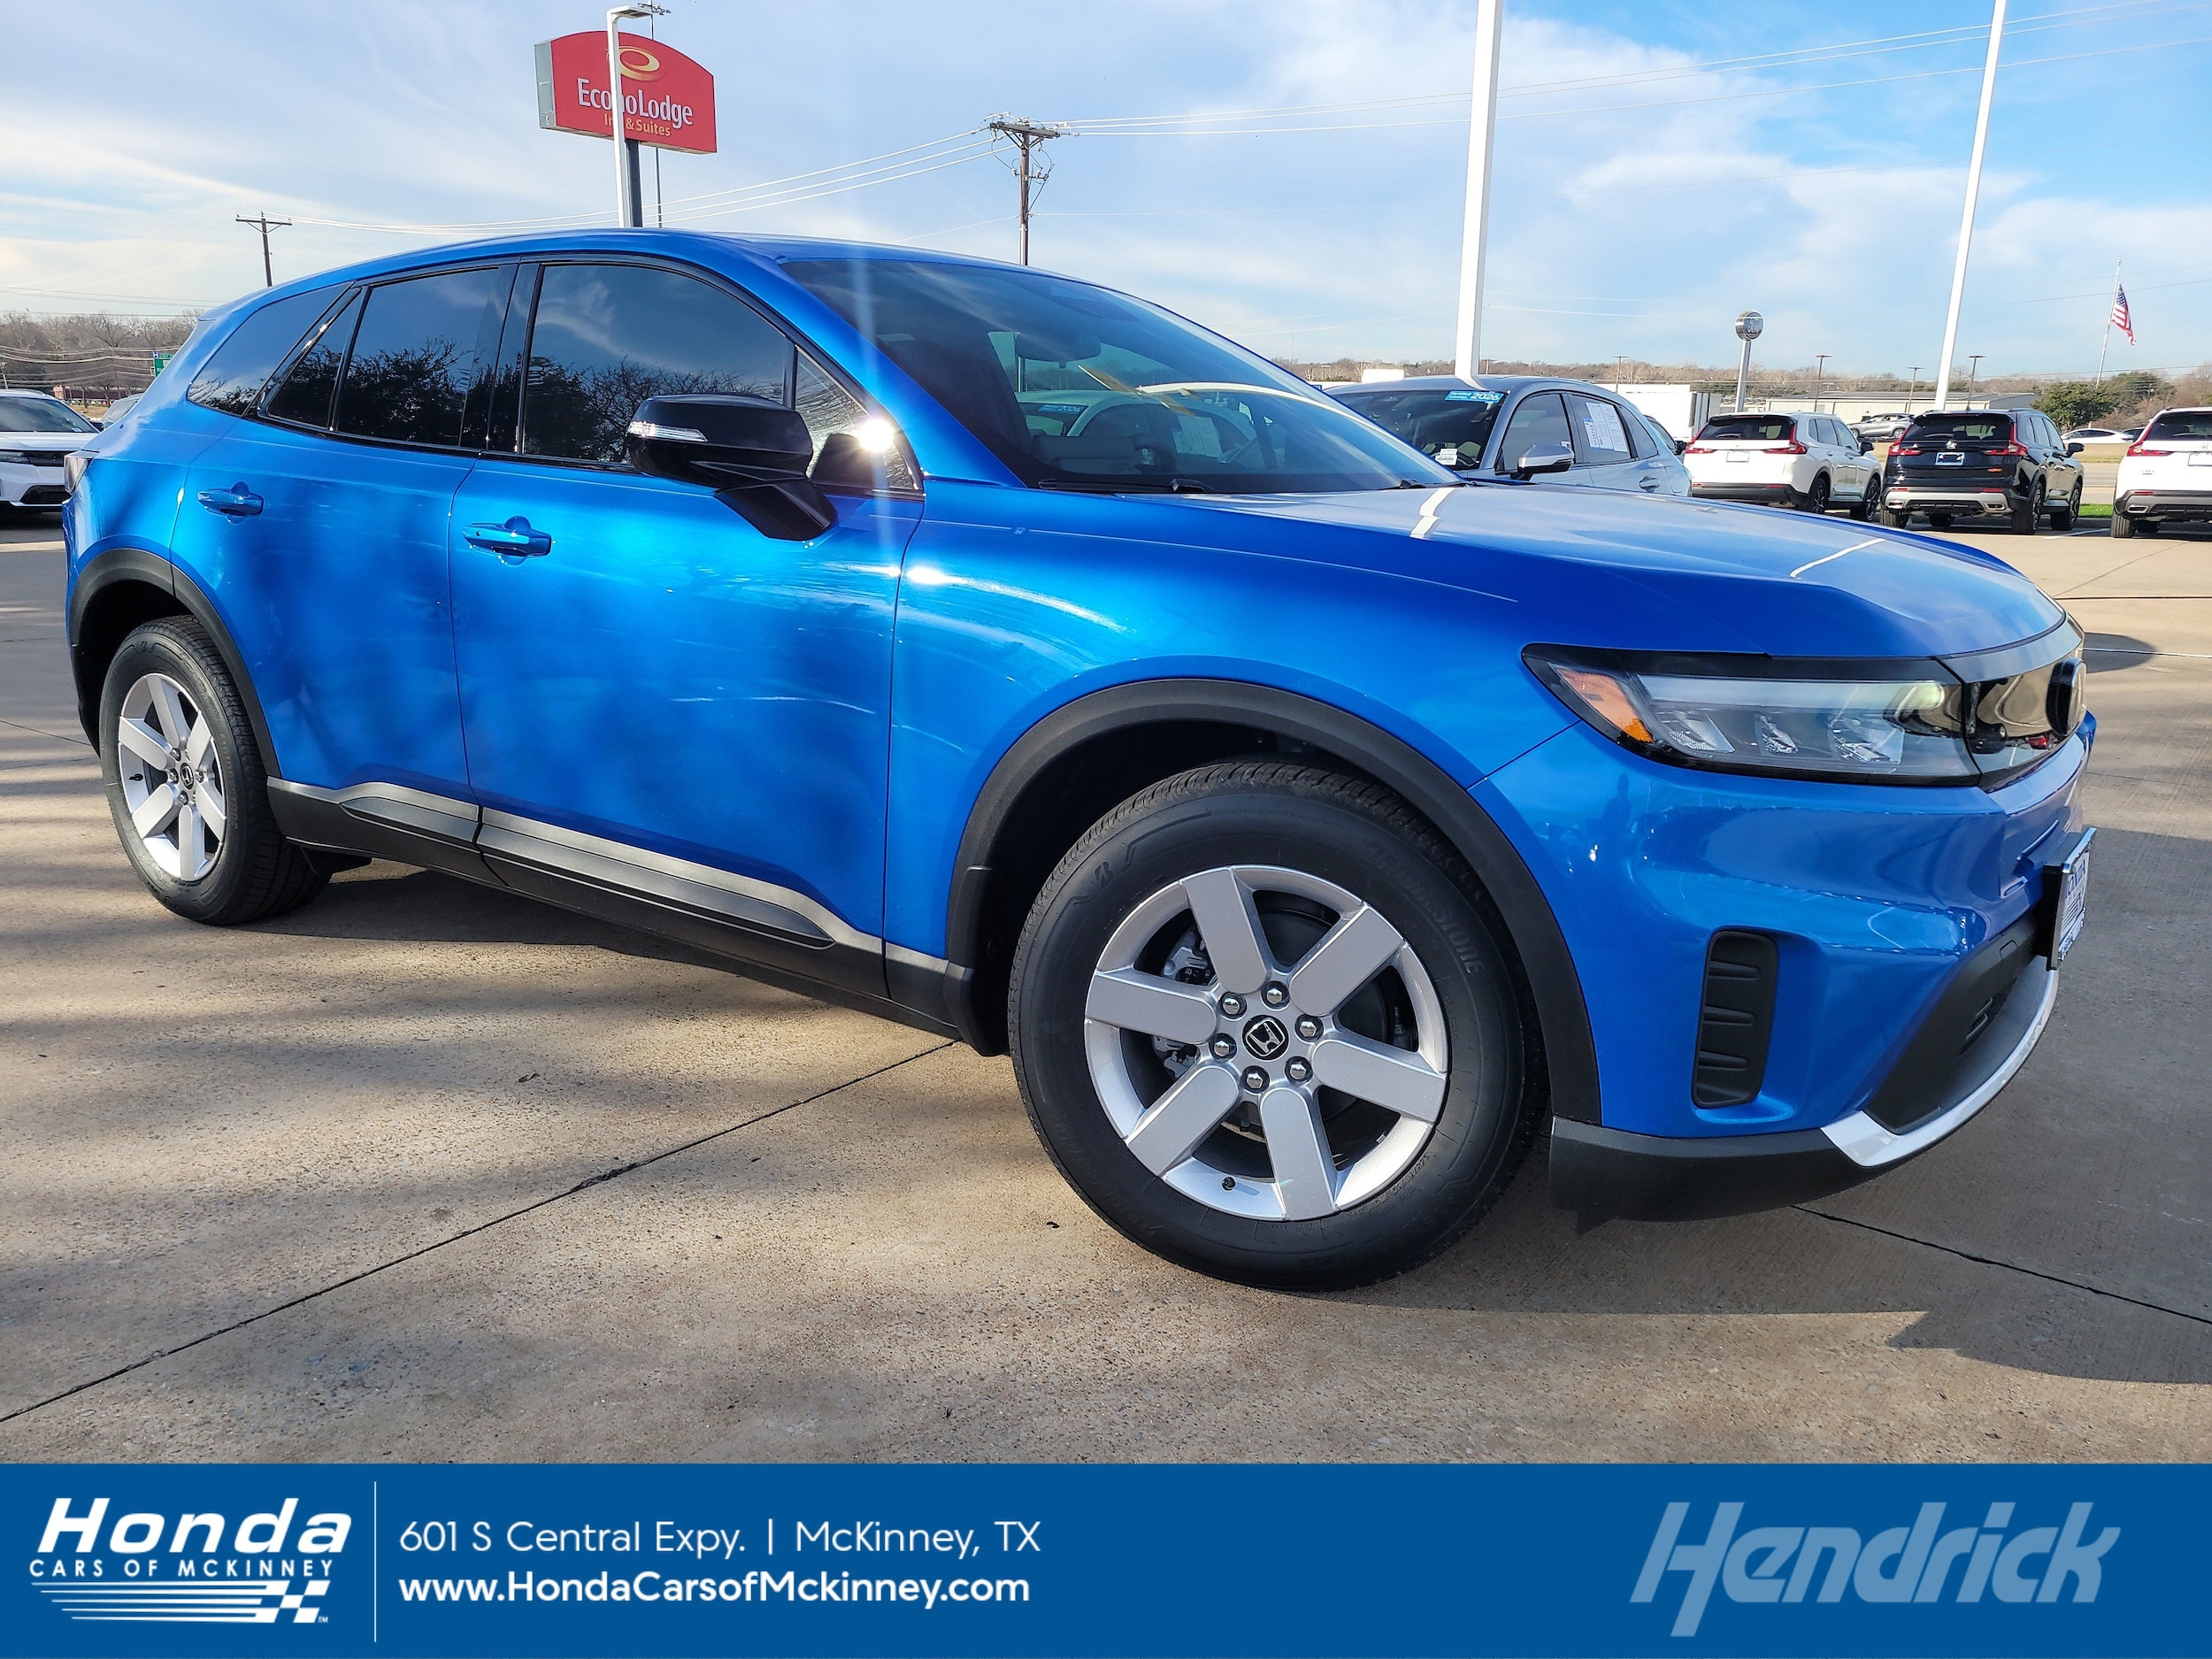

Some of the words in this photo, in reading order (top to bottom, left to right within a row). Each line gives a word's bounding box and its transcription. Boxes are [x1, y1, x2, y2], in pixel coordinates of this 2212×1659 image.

[577, 77, 694, 129] EcooLodge
[626, 118, 634, 130] &
[636, 119, 671, 136] Suites
[1470, 392, 1501, 401] 2026
